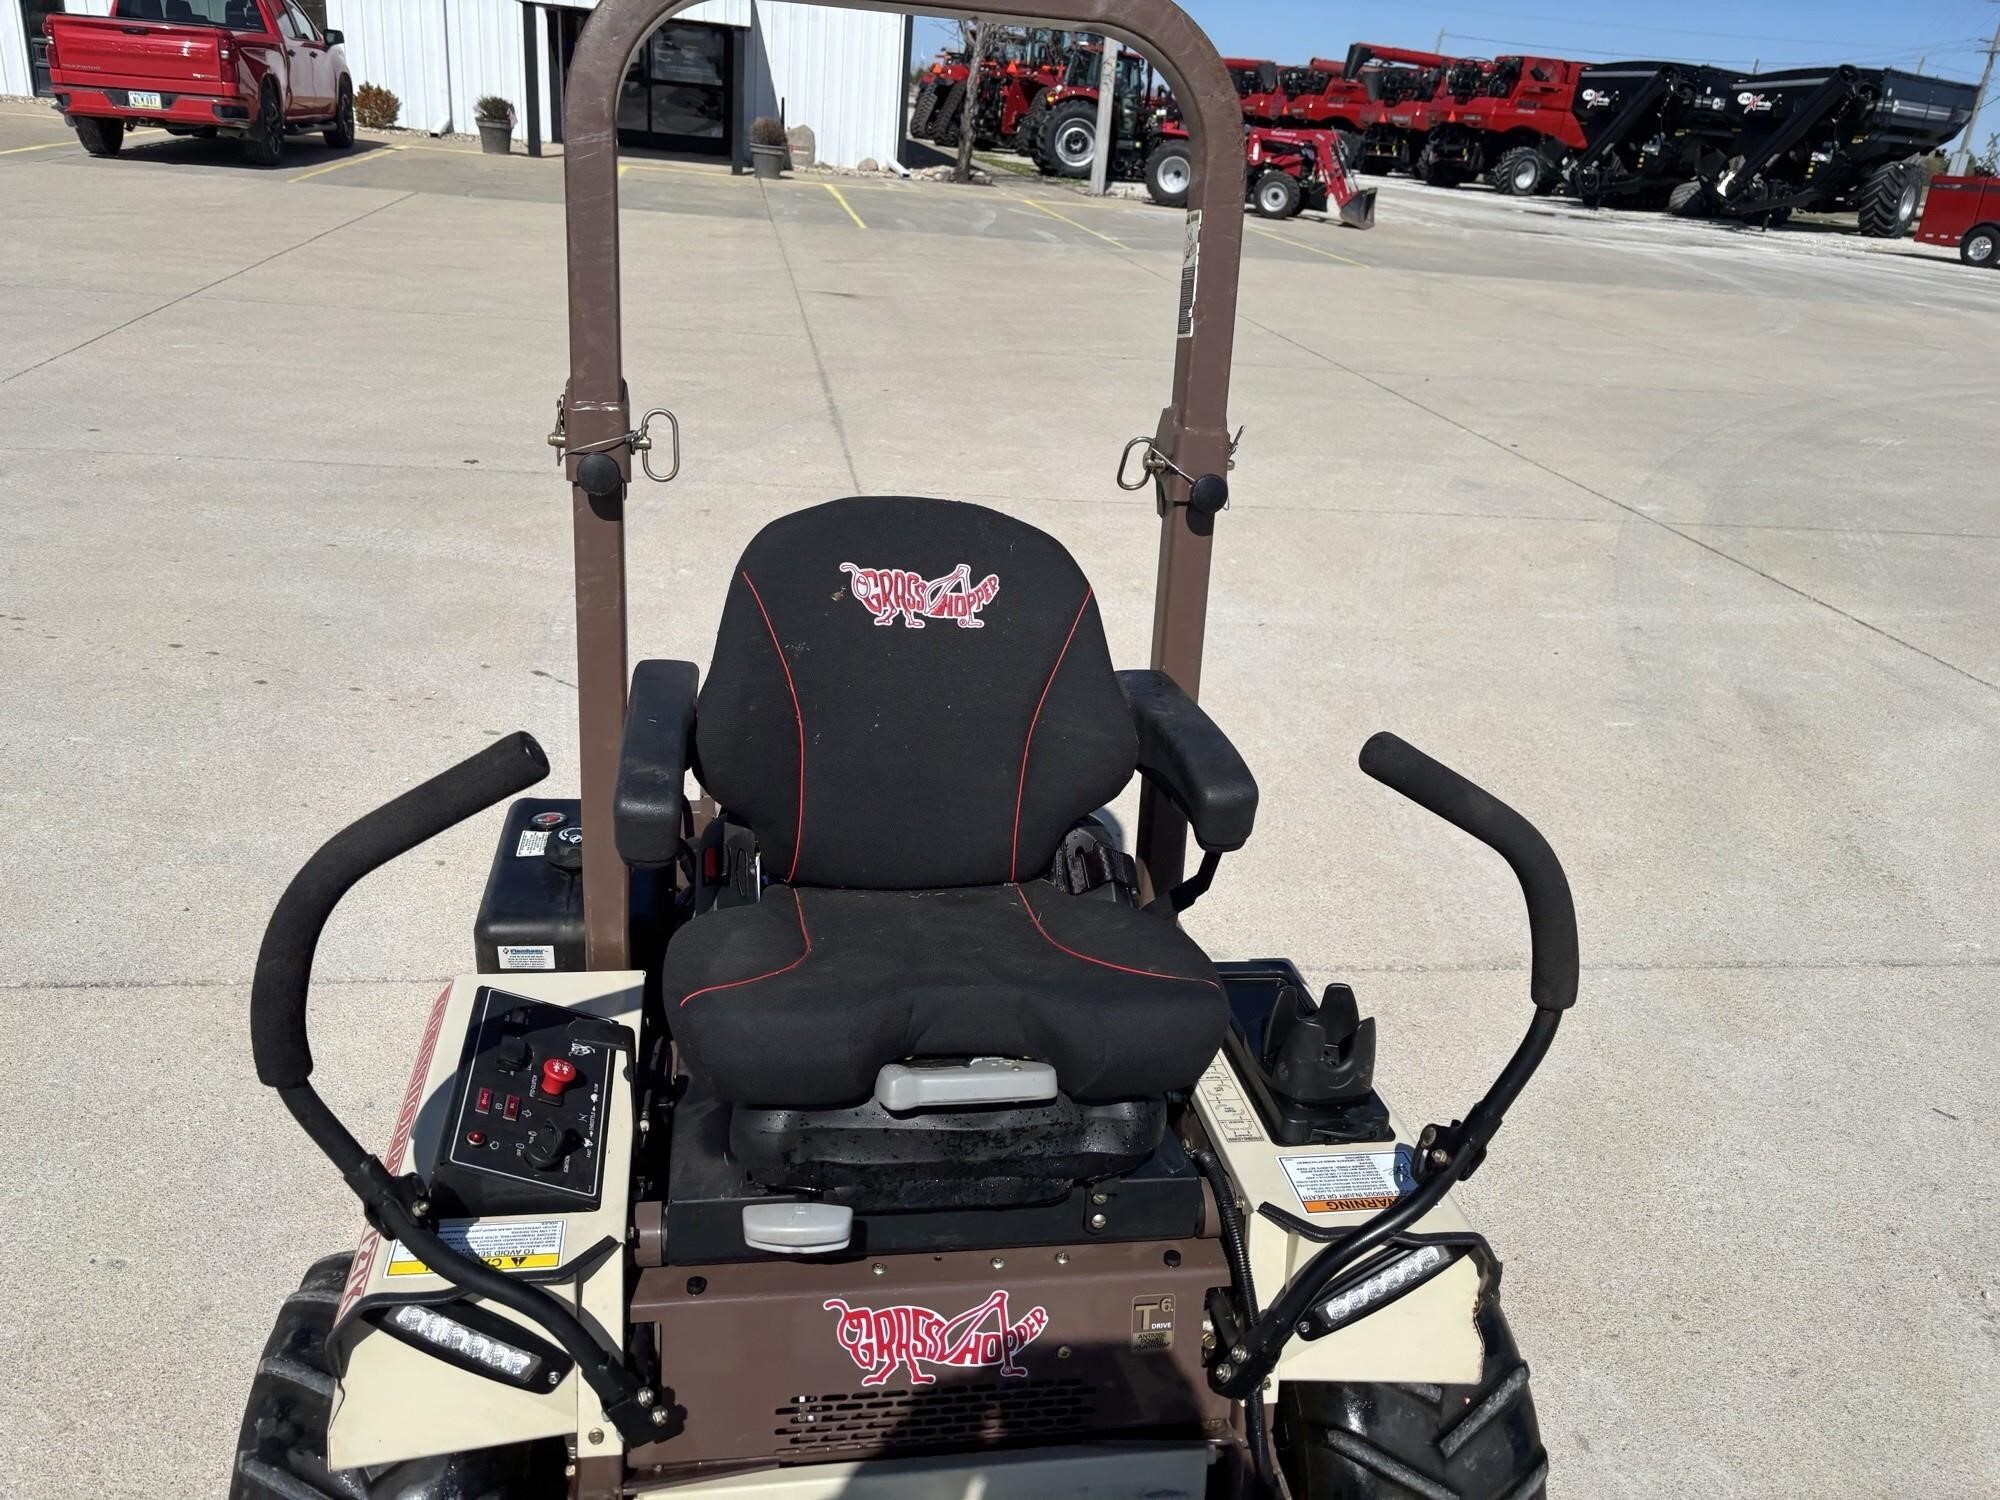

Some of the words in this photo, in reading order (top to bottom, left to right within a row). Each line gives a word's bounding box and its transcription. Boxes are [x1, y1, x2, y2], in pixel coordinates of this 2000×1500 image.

[845, 563, 1000, 628] GRASSHOPPER
[1326, 1199, 1397, 1210] WARNING
[834, 1291, 1049, 1386] GRASSHOPPER
[1151, 1322, 1172, 1330] DRIVE
